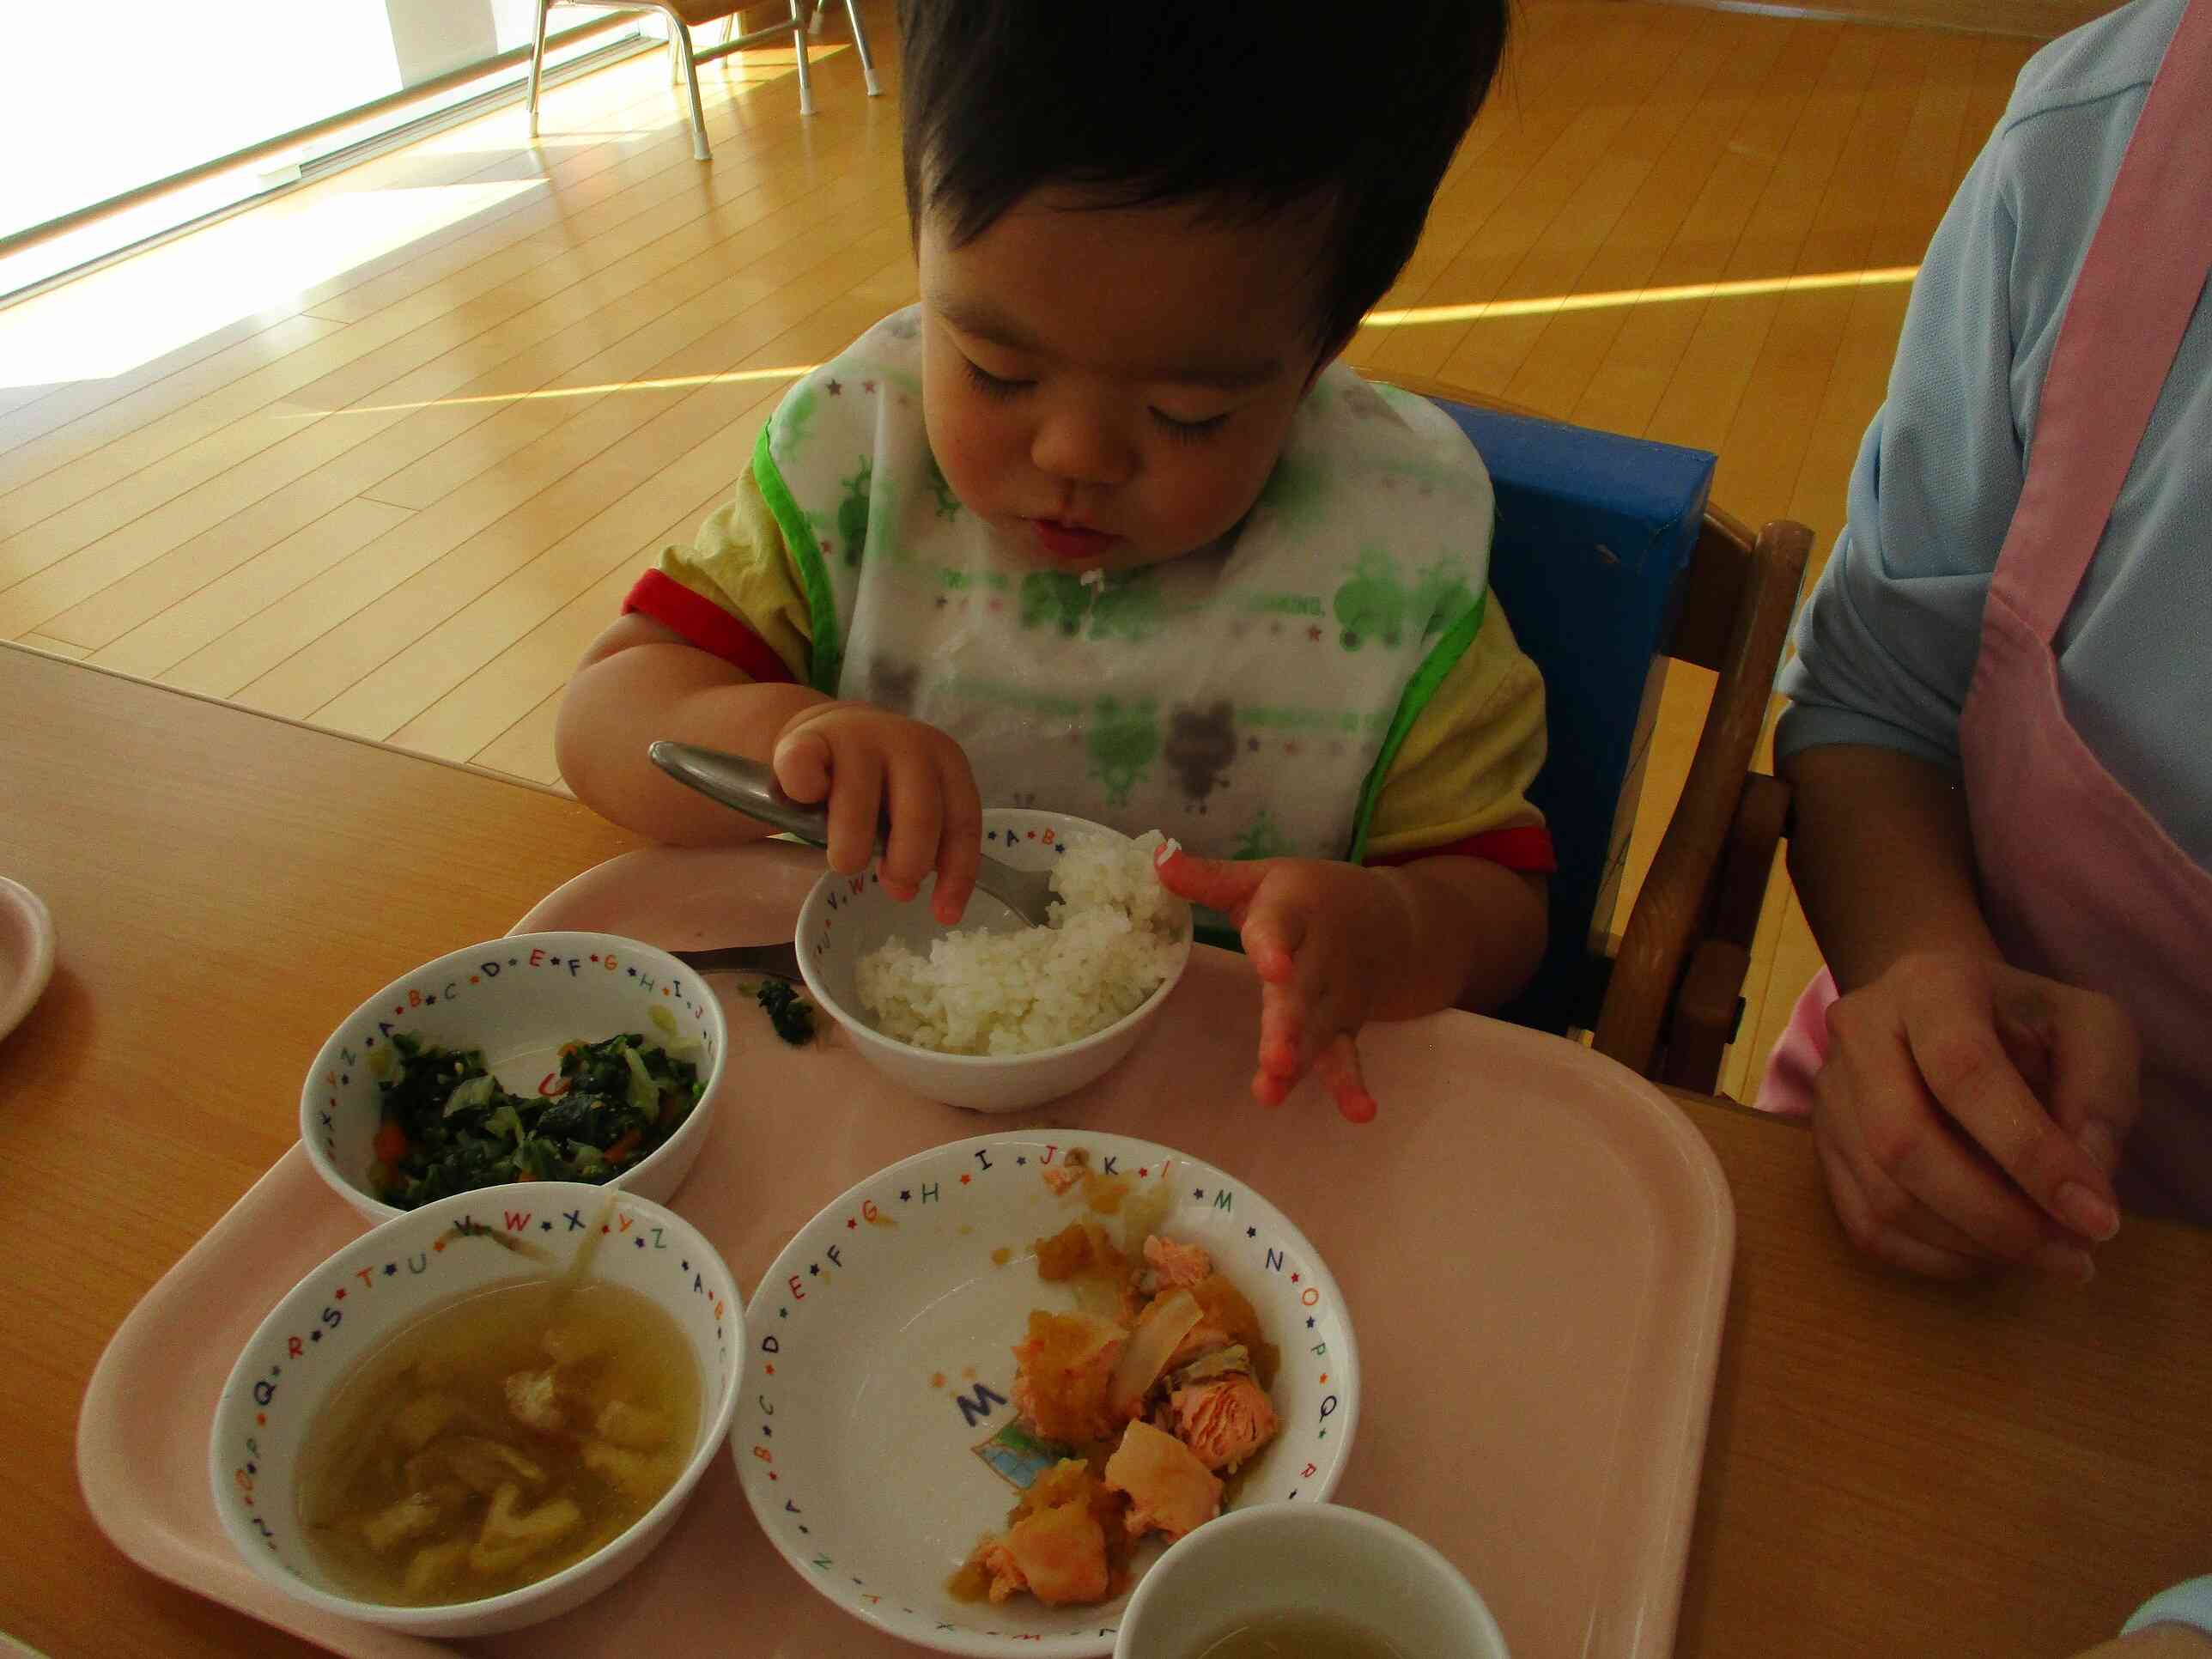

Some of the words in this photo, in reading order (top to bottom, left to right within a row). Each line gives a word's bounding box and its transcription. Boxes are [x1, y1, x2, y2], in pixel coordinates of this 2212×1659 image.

[1006, 821, 1019, 847] A
[1042, 829, 1055, 845] B
[847, 872, 864, 895] W
[378, 1022, 395, 1038] A
[408, 989, 422, 1008] B
[444, 982, 458, 1000] C
[480, 962, 501, 977] D
[529, 947, 546, 967] E
[568, 959, 581, 977] F
[604, 954, 618, 971] G
[639, 974, 655, 993] H
[672, 980, 683, 999] I
[974, 1149, 993, 1171] I
[1040, 1146, 1058, 1164] J
[1103, 1156, 1119, 1176] K
[921, 1182, 939, 1204] H
[1213, 1188, 1233, 1212] M
[861, 1199, 878, 1223] G
[826, 1244, 843, 1268] F
[1265, 1248, 1284, 1271] N
[787, 1275, 805, 1300] E
[1301, 1288, 1320, 1306] O
[253, 1381, 276, 1406] Q
[288, 1335, 304, 1359] R
[321, 1307, 343, 1329] S
[356, 1266, 374, 1288] T
[407, 1253, 427, 1275] U
[503, 1209, 532, 1232] W
[562, 1209, 586, 1232] X
[618, 1213, 635, 1233] Y
[650, 1228, 667, 1249] Z
[693, 1273, 703, 1294] A
[762, 1335, 779, 1353] D
[1310, 1342, 1327, 1357] P
[759, 1395, 774, 1416] C
[1318, 1395, 1337, 1423] Q
[753, 1445, 772, 1464] B
[1300, 1462, 1317, 1479] R
